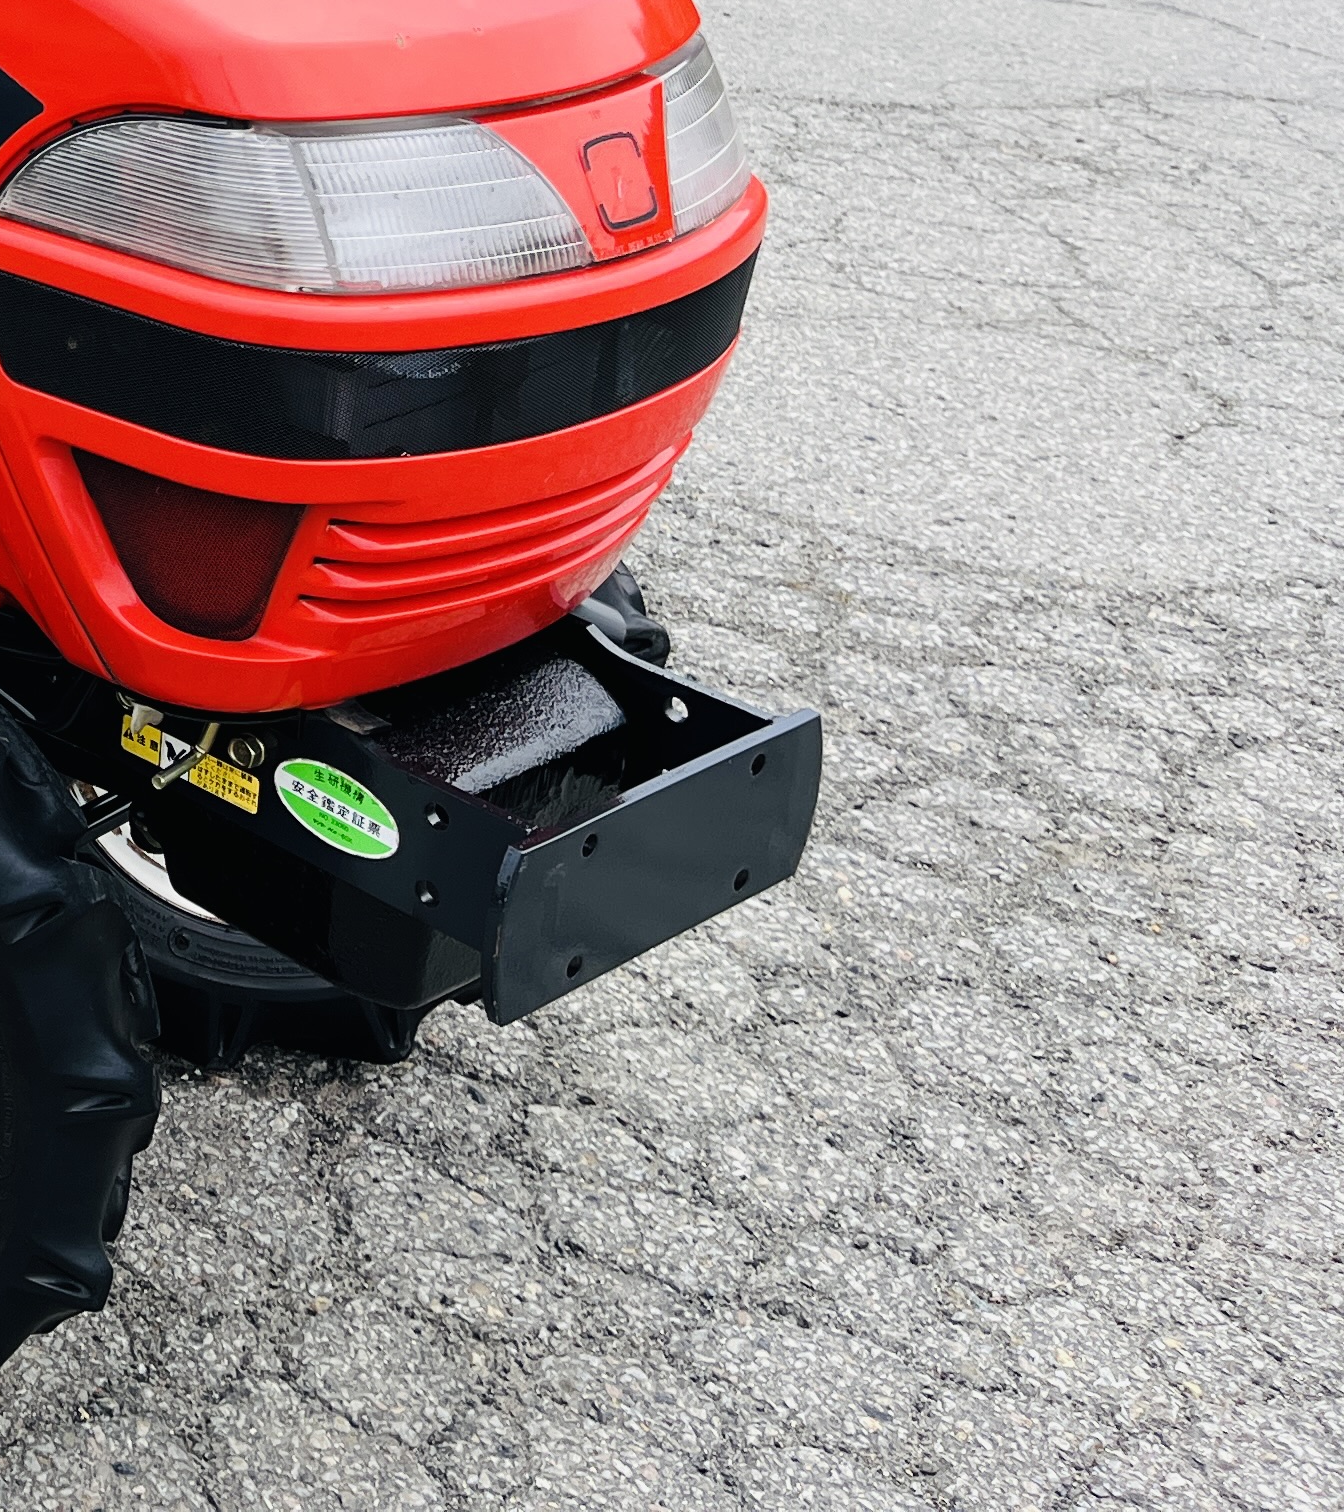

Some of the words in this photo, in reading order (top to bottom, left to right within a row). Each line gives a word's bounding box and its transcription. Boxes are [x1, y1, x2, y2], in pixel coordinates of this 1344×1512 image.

[292, 779, 381, 838] 安全鑑定証票
[314, 769, 365, 805] 生研機構
